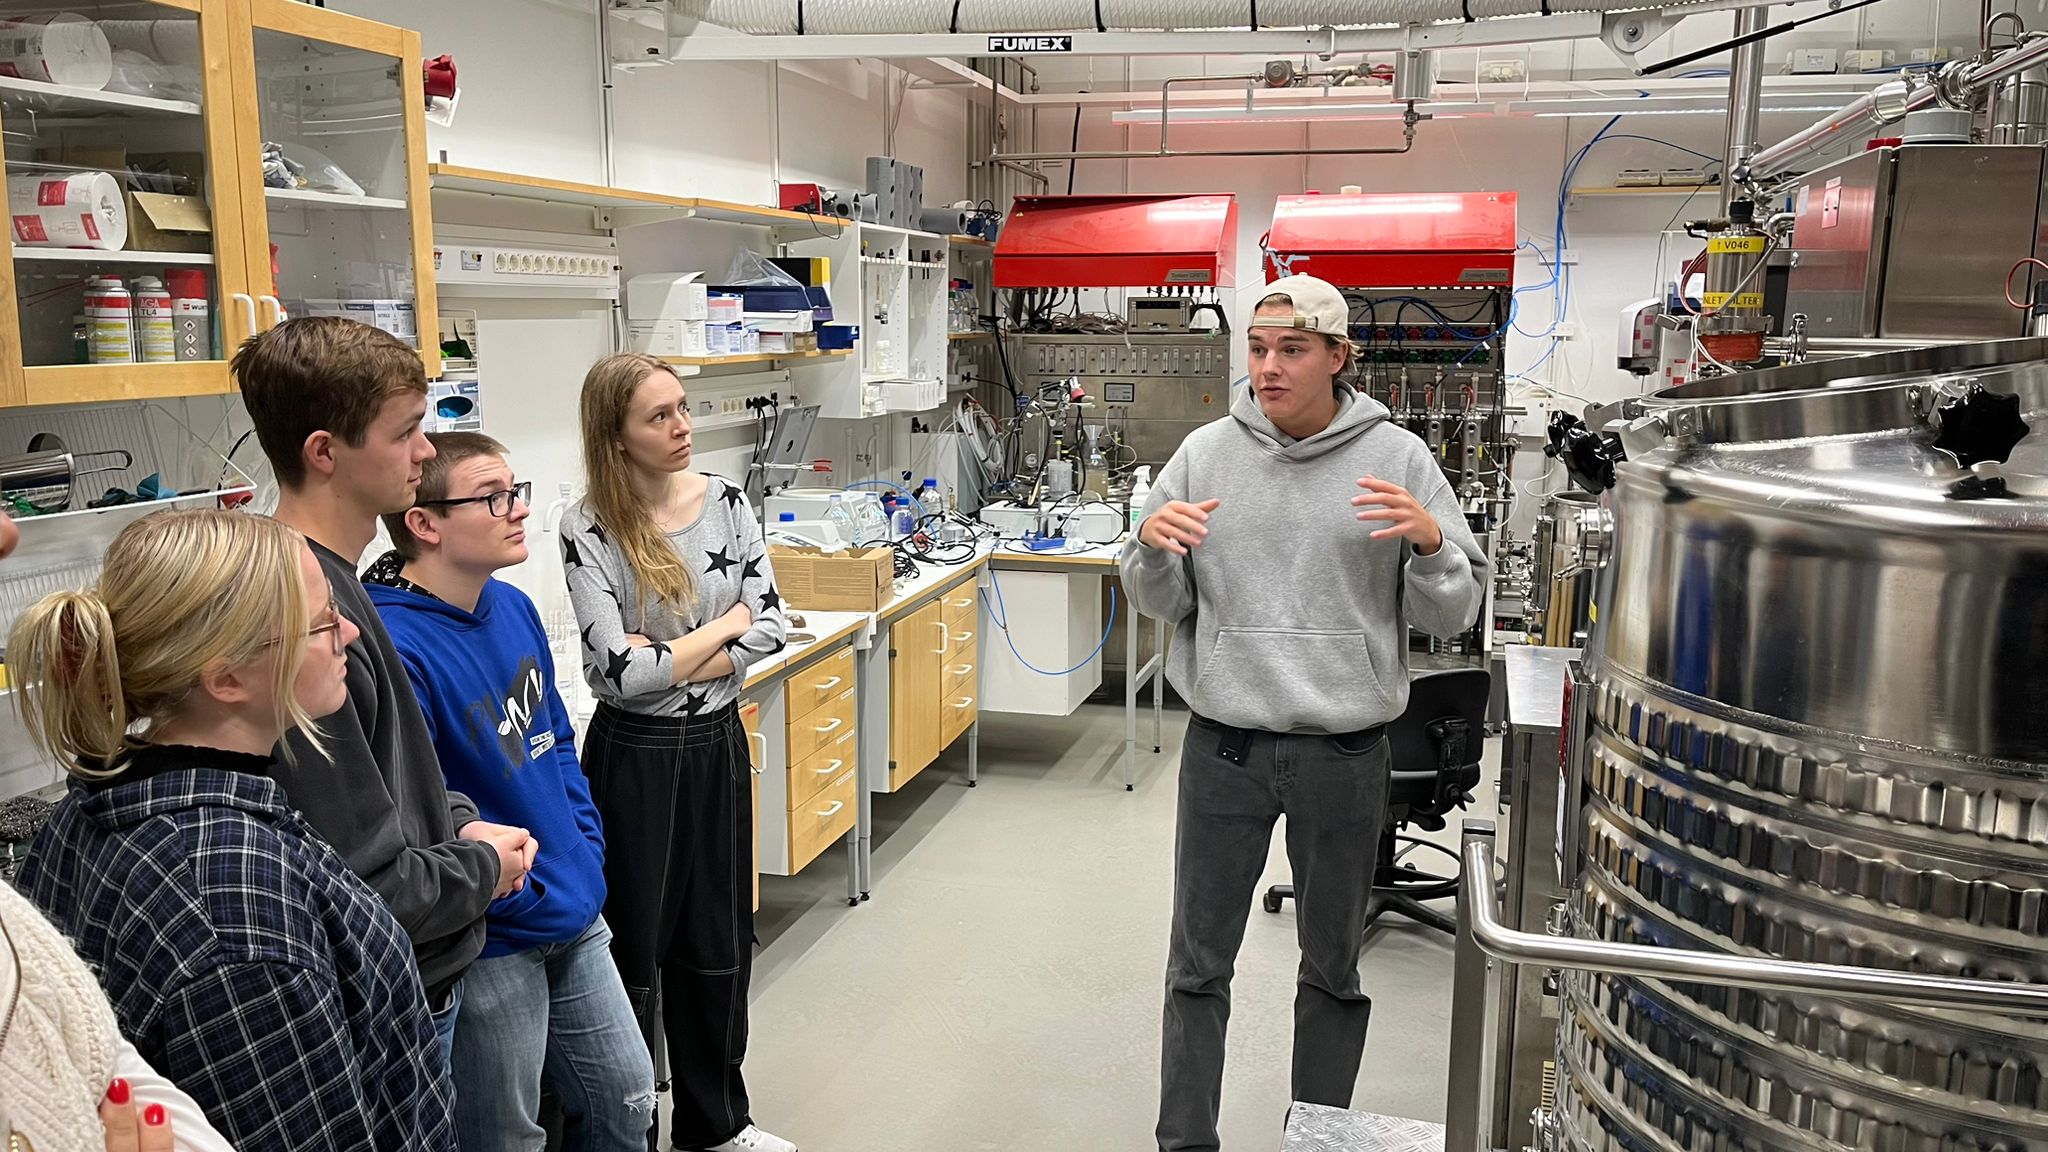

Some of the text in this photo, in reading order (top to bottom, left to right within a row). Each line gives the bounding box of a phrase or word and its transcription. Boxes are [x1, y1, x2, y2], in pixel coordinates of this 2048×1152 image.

[989, 37, 1065, 51] FUMEX
[1724, 240, 1749, 250] V046
[140, 297, 160, 308] AGA
[1703, 296, 1722, 305] NLET
[140, 308, 157, 316] TL4
